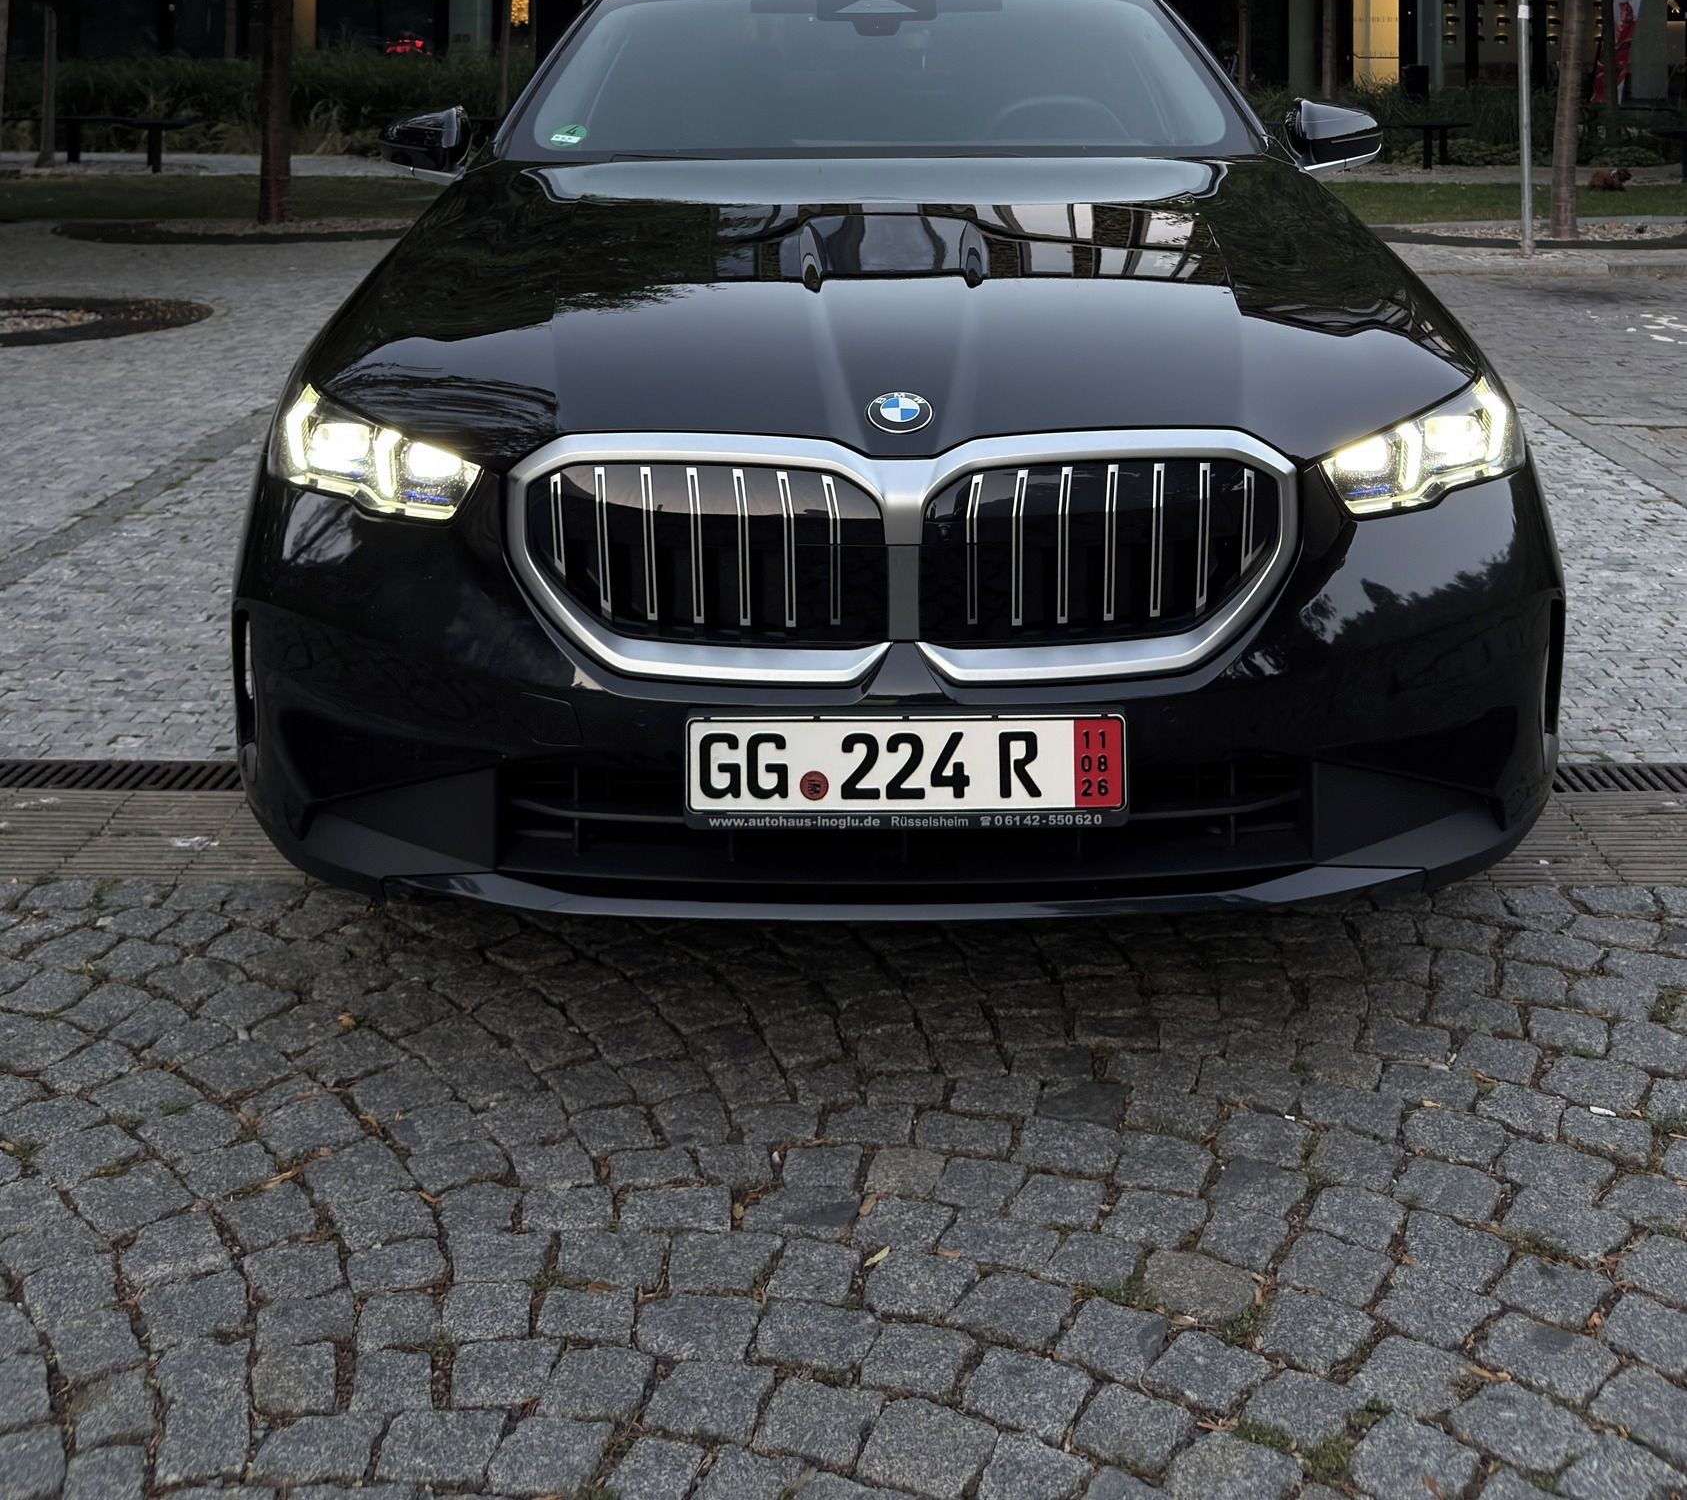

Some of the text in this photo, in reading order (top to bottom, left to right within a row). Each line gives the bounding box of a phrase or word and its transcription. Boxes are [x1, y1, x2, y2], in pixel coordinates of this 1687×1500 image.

[566, 124, 578, 136] 4
[874, 392, 926, 404] BMW
[1082, 729, 1106, 749] 11
[699, 730, 1042, 800] GG 224 R
[1081, 754, 1108, 773] 08
[1081, 778, 1109, 797] 26
[708, 815, 881, 829] www.autohaus-inoglu.de
[891, 815, 969, 828] Rüsselsheim
